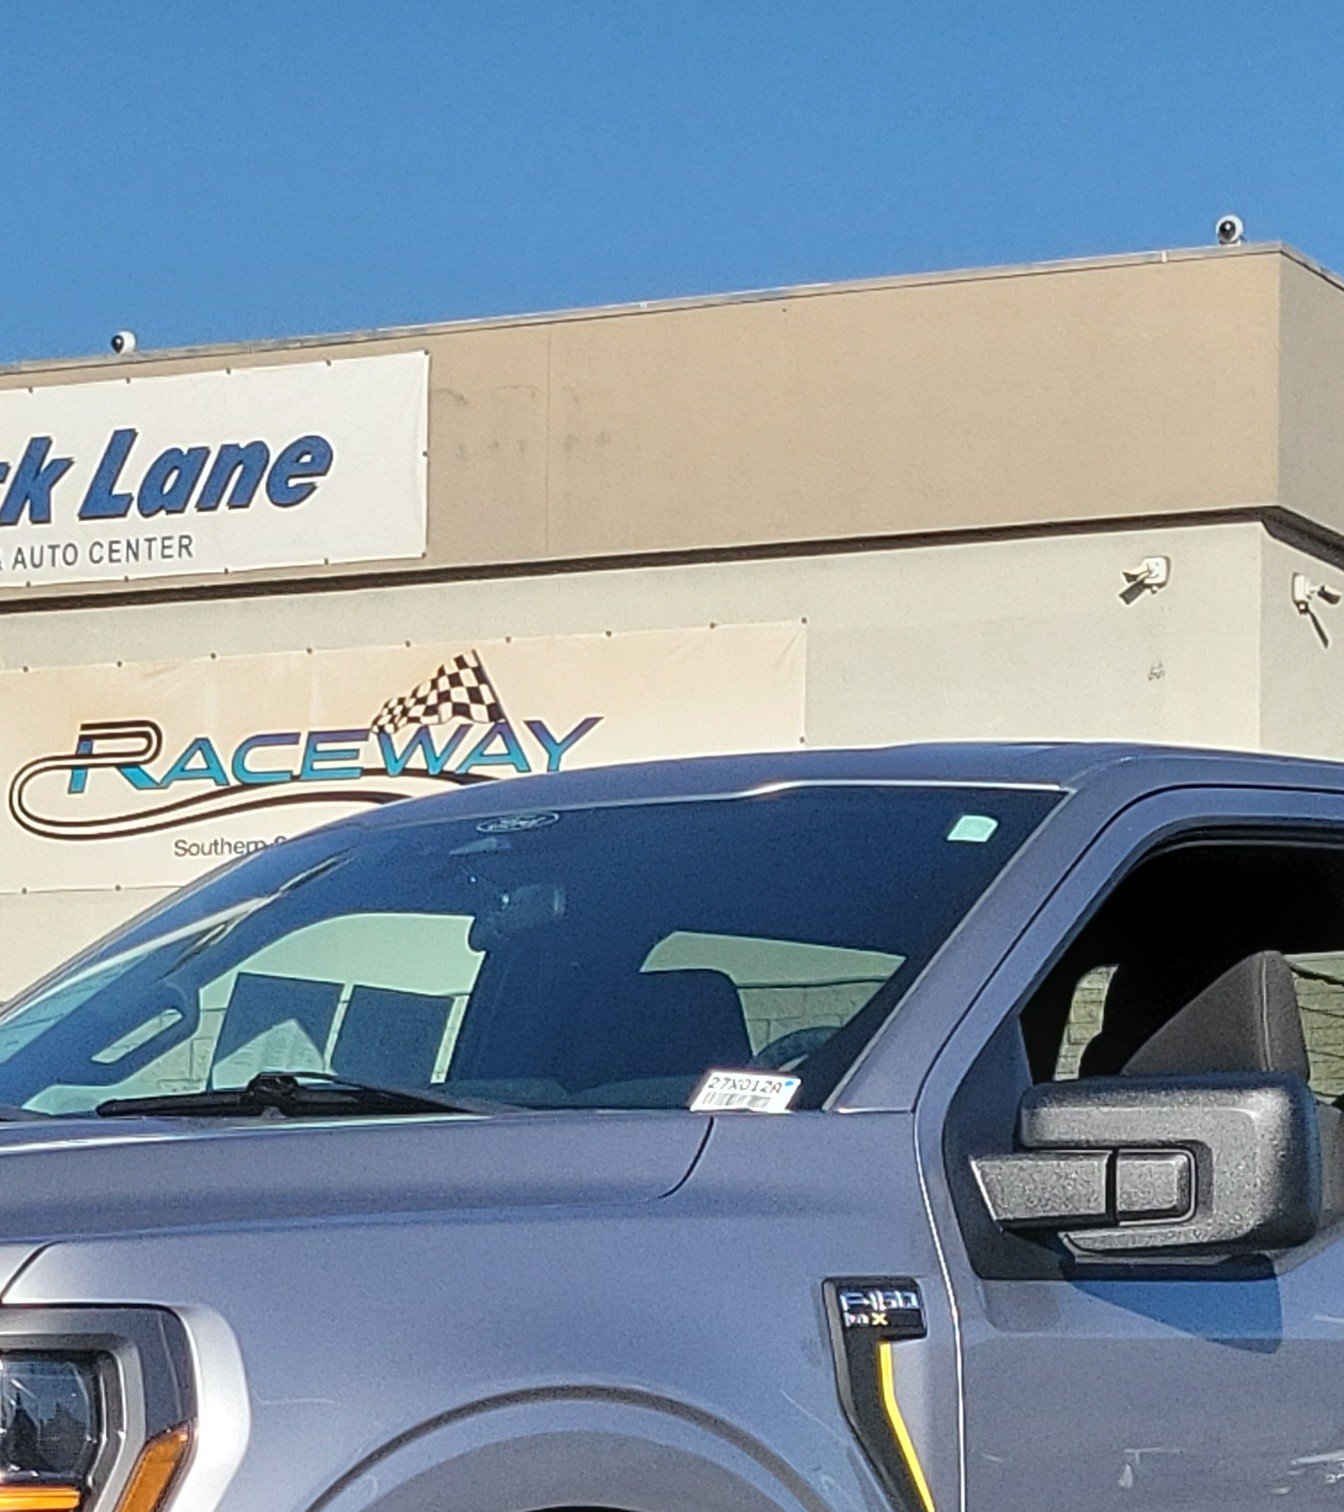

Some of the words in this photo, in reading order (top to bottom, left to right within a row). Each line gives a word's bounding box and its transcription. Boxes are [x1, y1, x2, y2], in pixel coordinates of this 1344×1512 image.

[78, 428, 335, 523] Lane
[11, 541, 81, 572] AUTO
[88, 534, 195, 567] CENTER
[68, 715, 605, 794] RACEWAY
[173, 835, 268, 857] Southern
